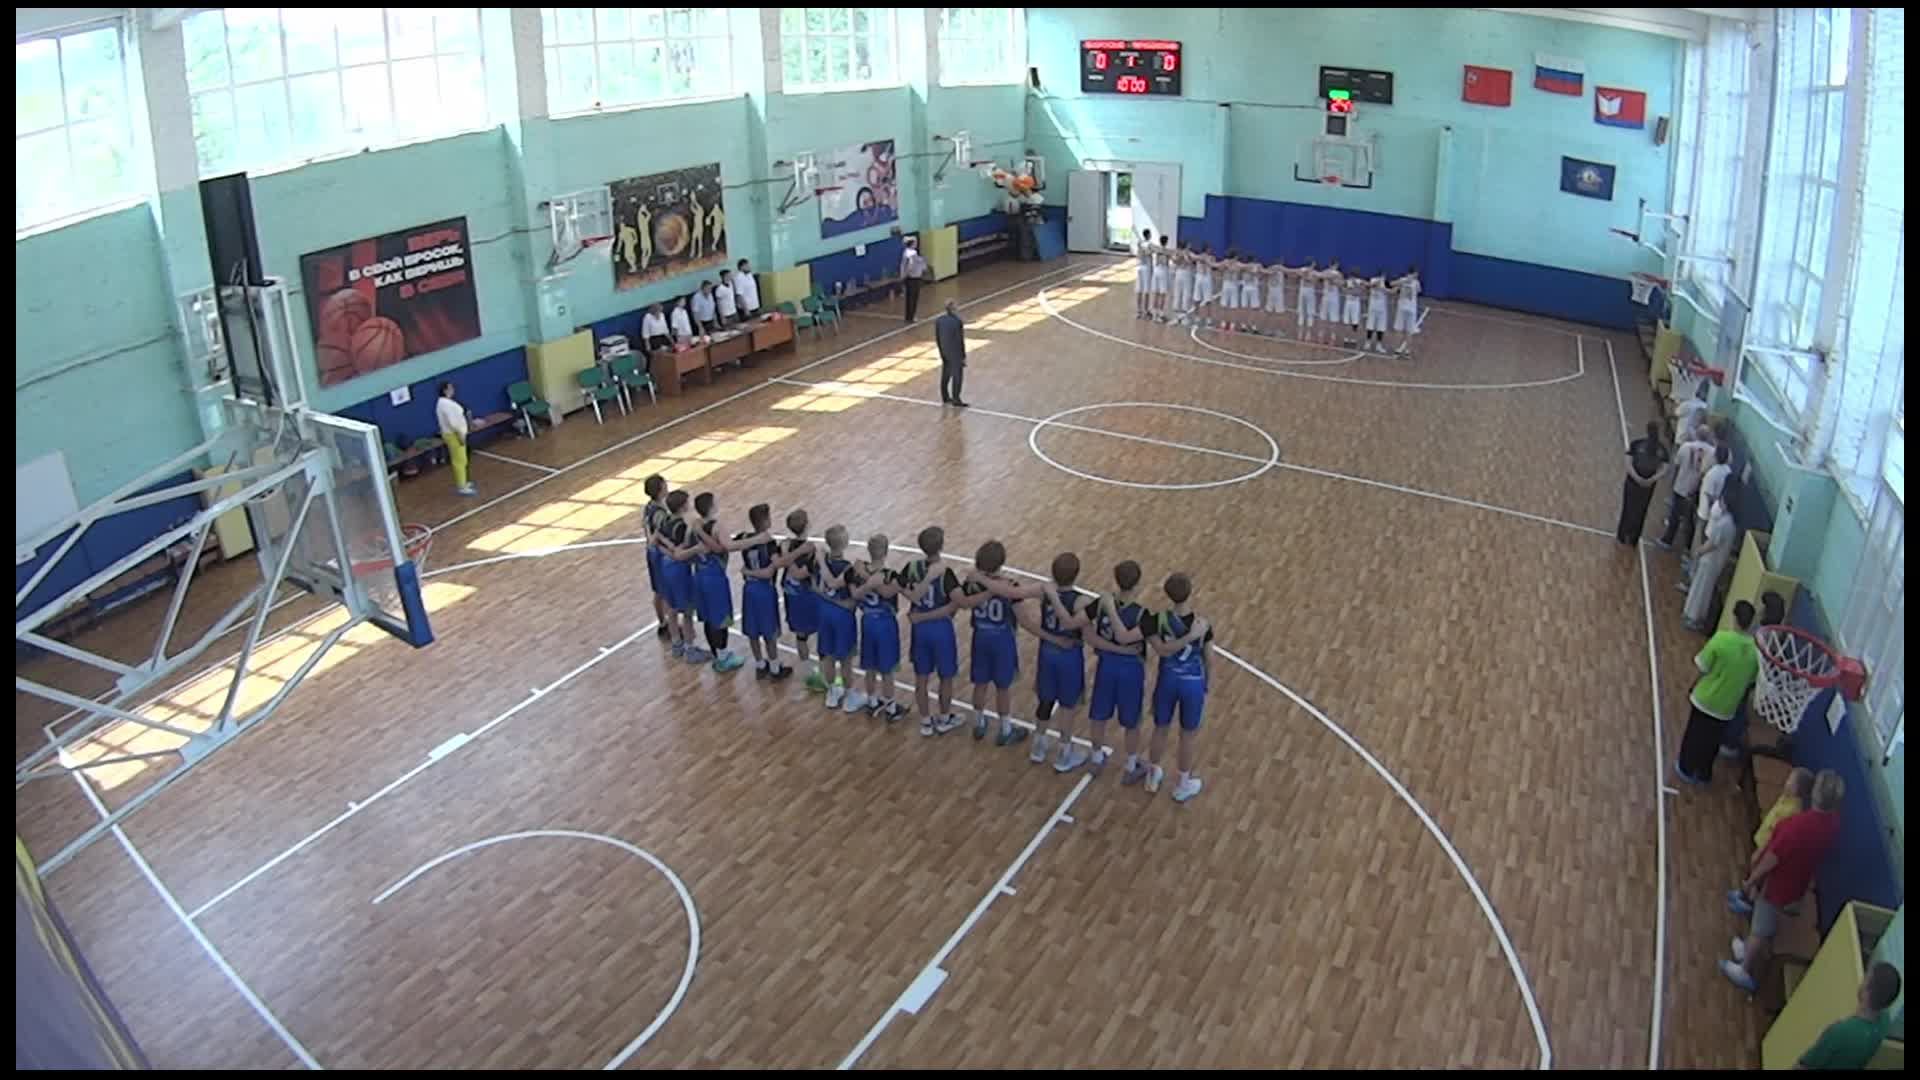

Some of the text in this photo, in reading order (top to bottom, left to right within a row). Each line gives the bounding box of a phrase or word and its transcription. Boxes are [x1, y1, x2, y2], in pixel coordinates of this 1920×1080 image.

[1096, 53, 1107, 70] 0
[1163, 54, 1175, 71] 0
[1117, 79, 1146, 93] 1000
[349, 269, 361, 281] В
[362, 256, 402, 277] СВОЙ
[374, 271, 404, 288] КАК
[405, 257, 464, 280] ВЕРИШЬ
[974, 599, 1004, 622] 30
